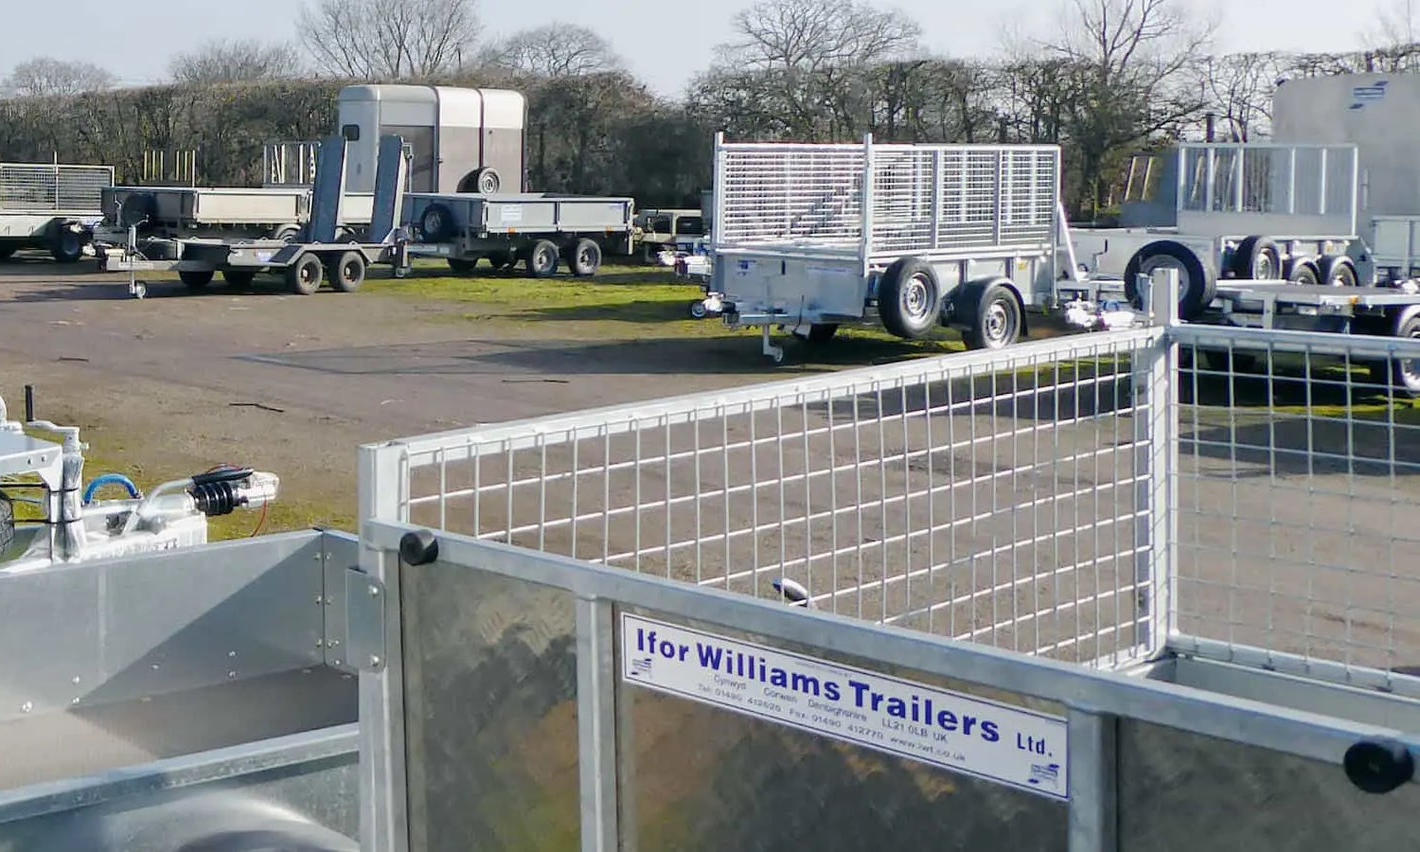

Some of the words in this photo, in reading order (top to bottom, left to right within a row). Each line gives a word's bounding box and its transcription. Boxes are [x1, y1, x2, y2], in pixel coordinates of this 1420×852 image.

[637, 628, 689, 661] Ifor
[696, 642, 841, 700] Williams
[848, 679, 1000, 742] Trailers
[1017, 732, 1053, 757] Ltd.
[881, 718, 905, 732] LL21
[933, 731, 948, 744] UK
